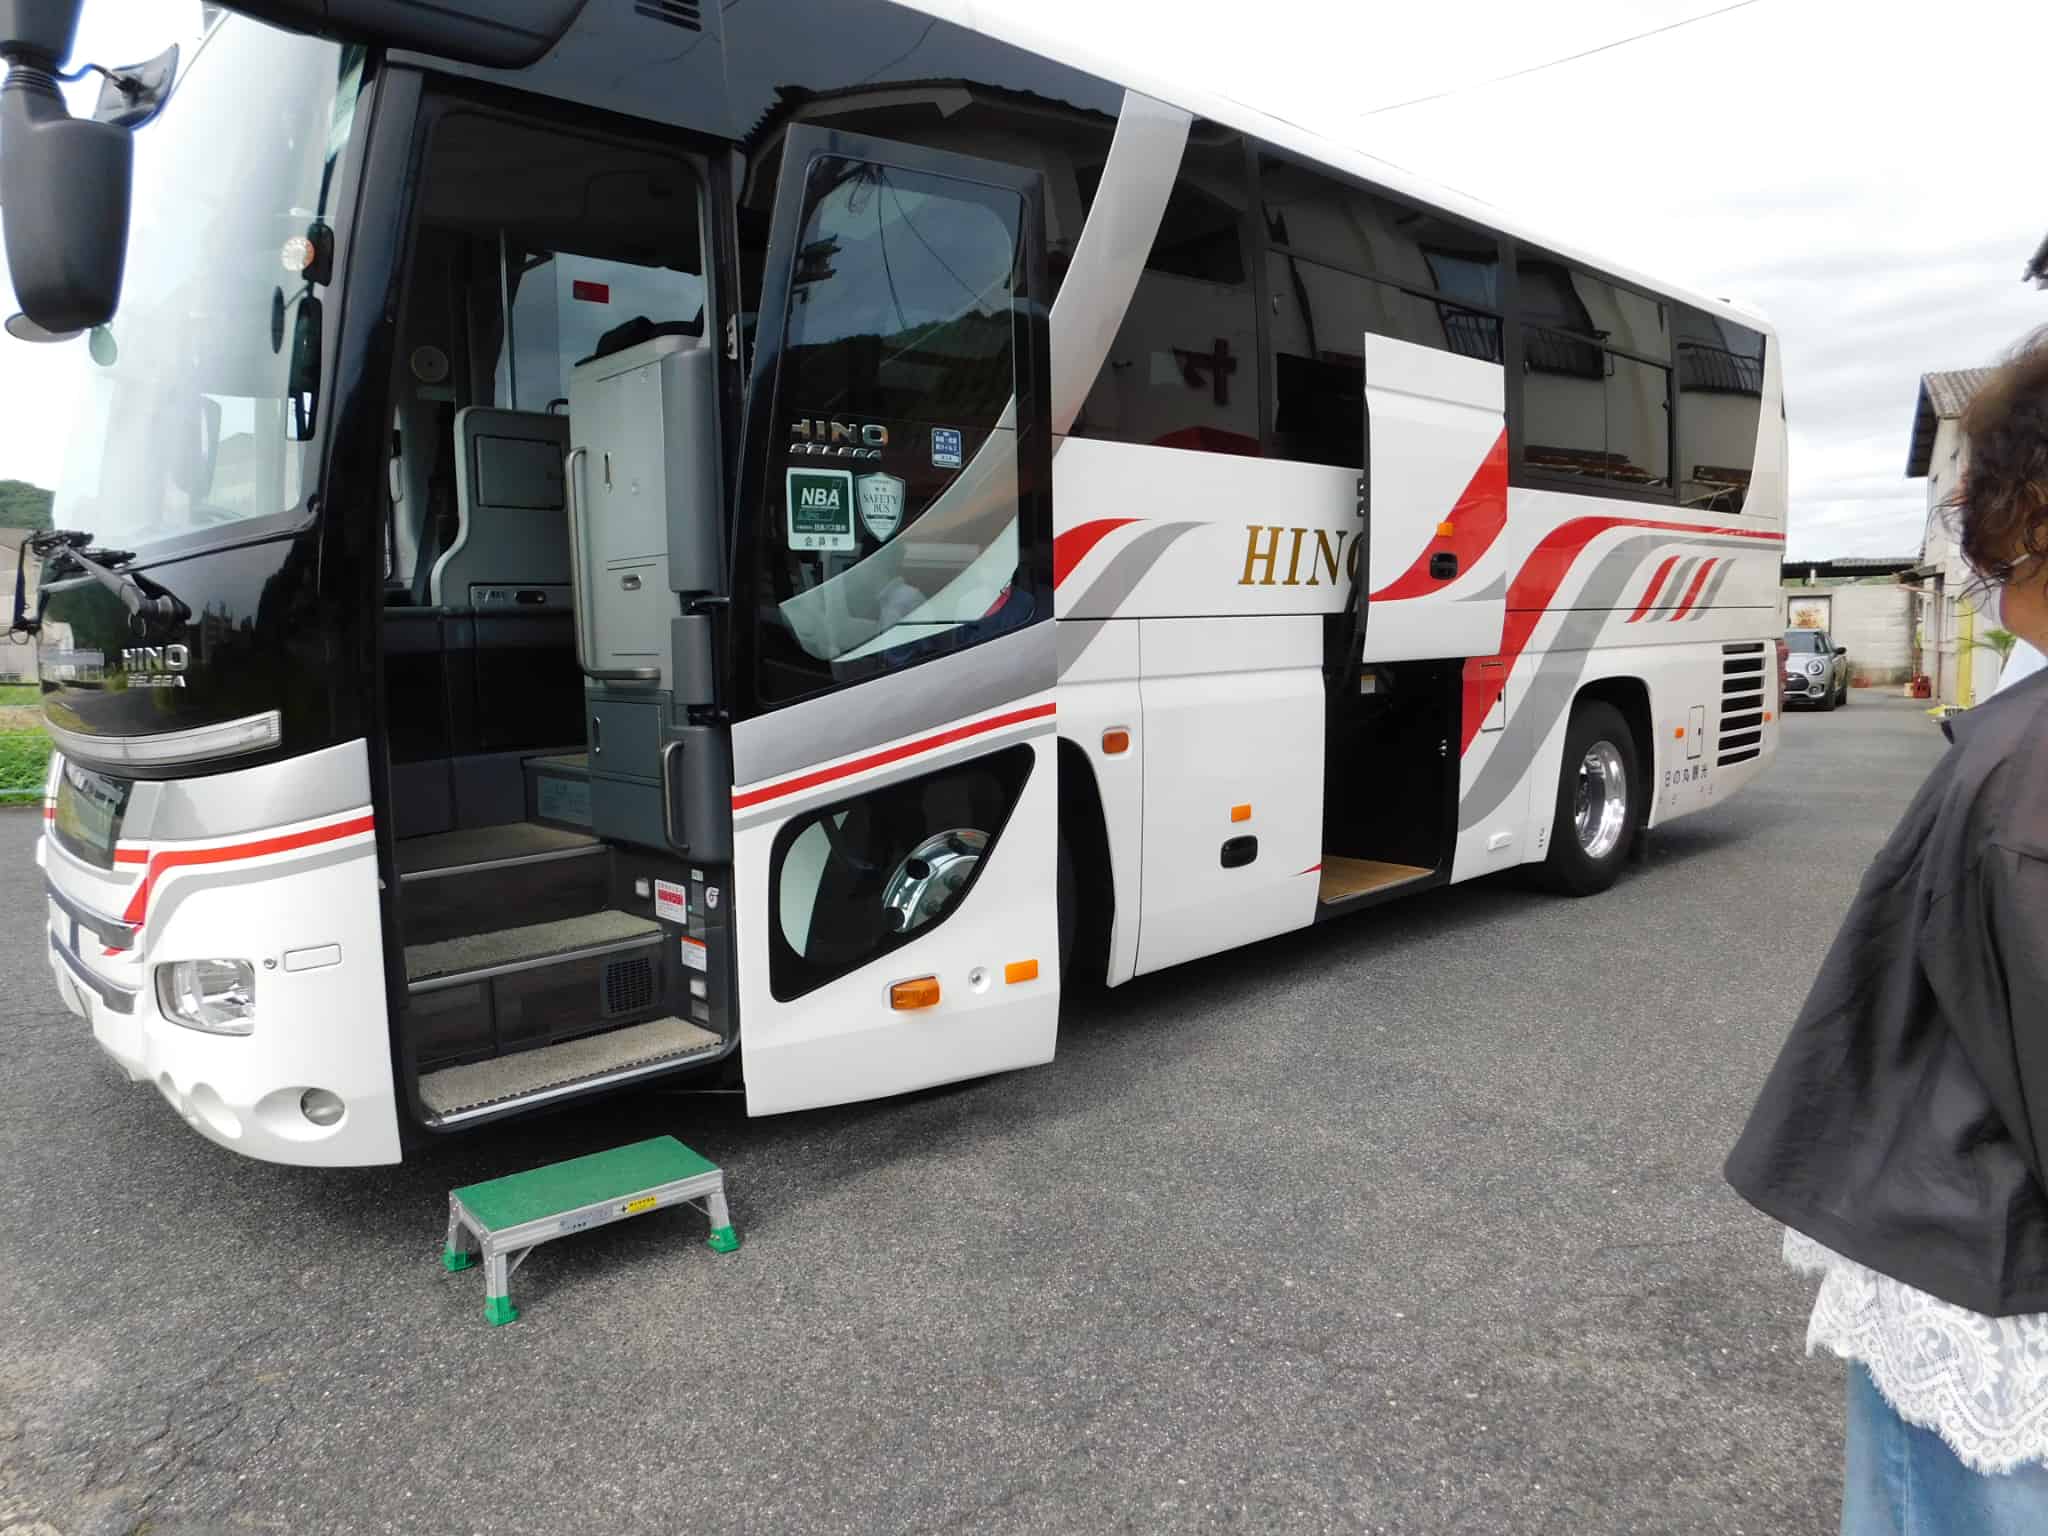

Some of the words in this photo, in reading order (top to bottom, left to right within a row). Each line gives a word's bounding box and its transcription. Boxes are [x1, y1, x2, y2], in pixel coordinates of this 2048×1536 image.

[801, 487, 840, 506] NBA
[863, 492, 898, 506] SAFETY
[873, 503, 891, 513] BUS
[121, 644, 188, 671] HINO
